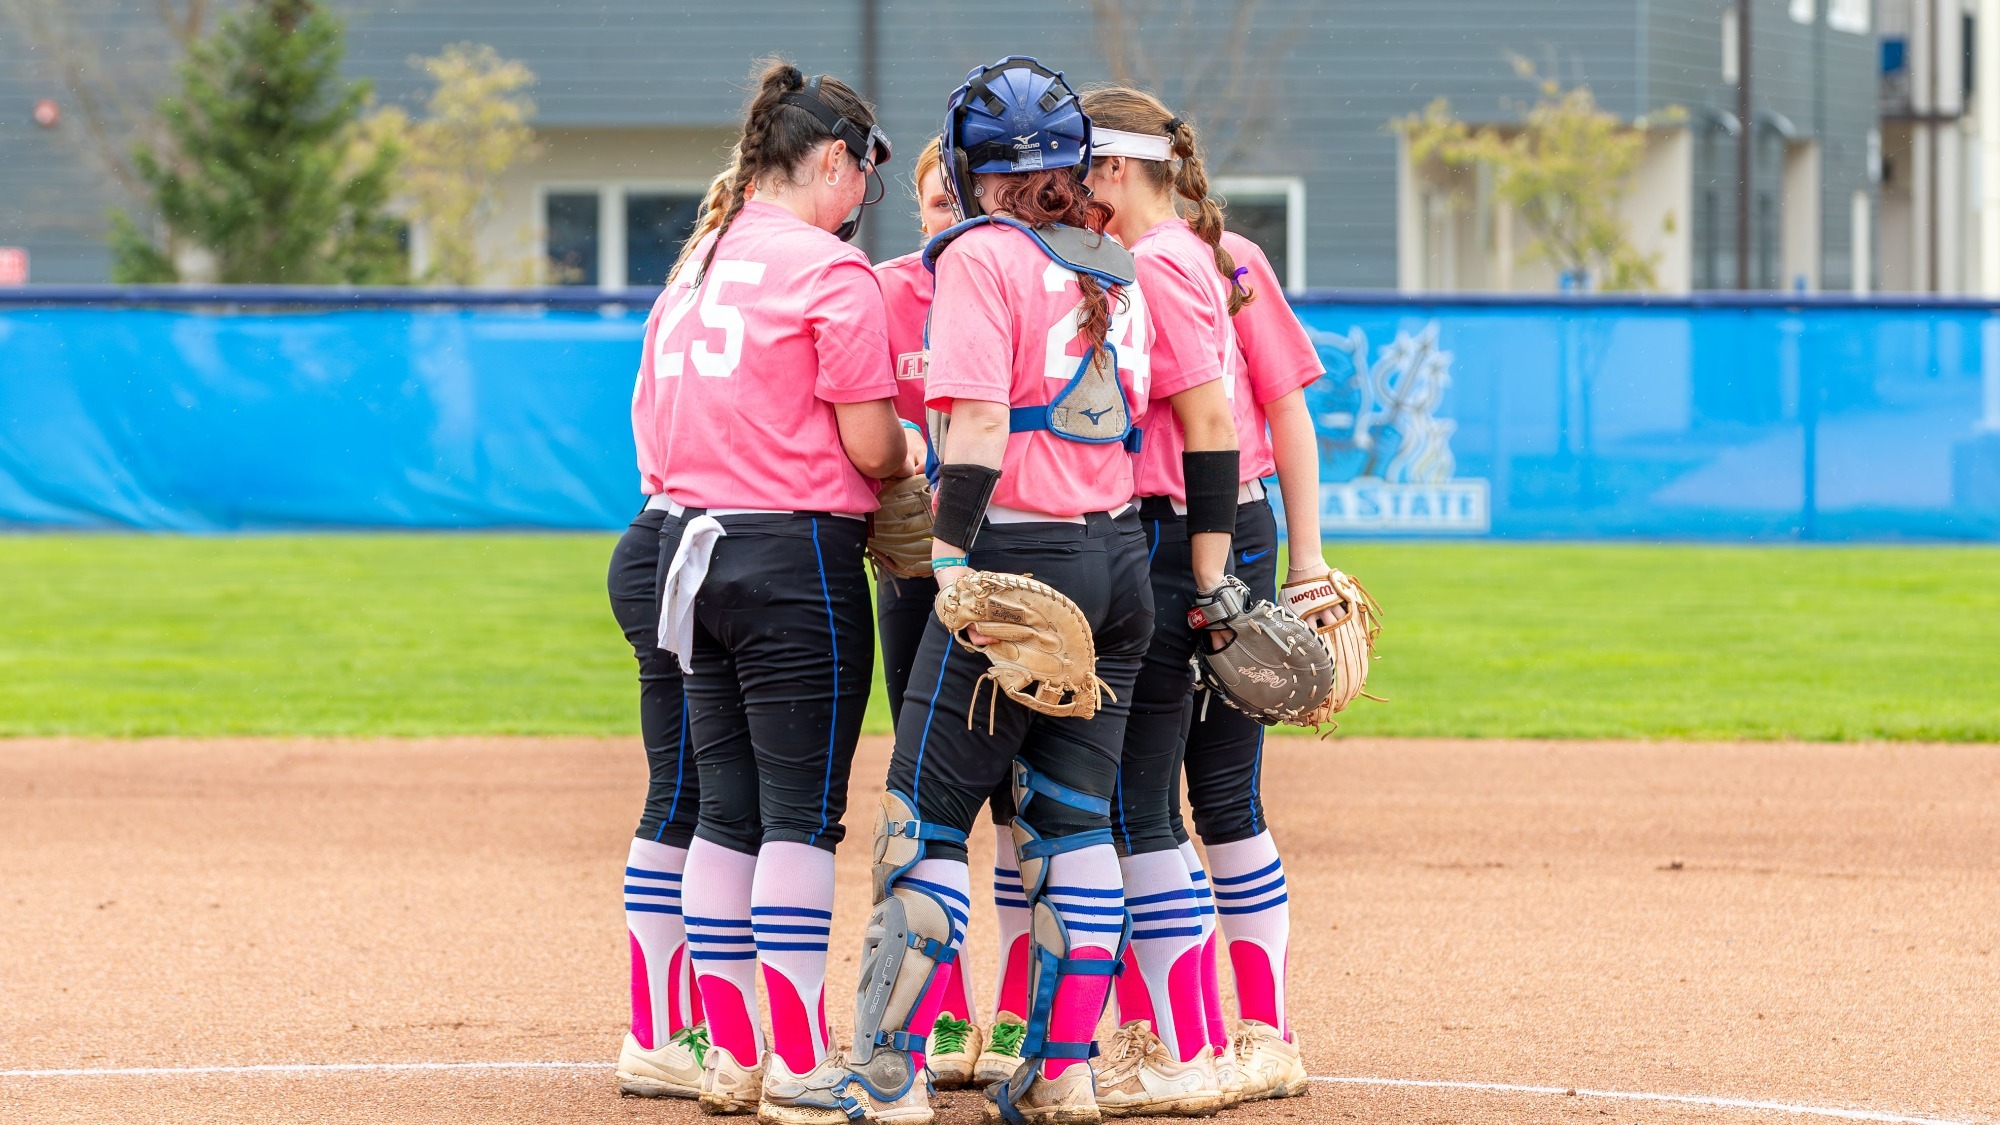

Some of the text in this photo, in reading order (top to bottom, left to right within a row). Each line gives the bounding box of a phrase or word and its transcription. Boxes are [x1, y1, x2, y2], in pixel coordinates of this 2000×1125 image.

[654, 259, 767, 379] 25
[1042, 260, 1150, 395] 24
[1289, 585, 1334, 605] Wilson
[1238, 666, 1288, 689] Rawlings
[869, 954, 894, 1015] samurai
